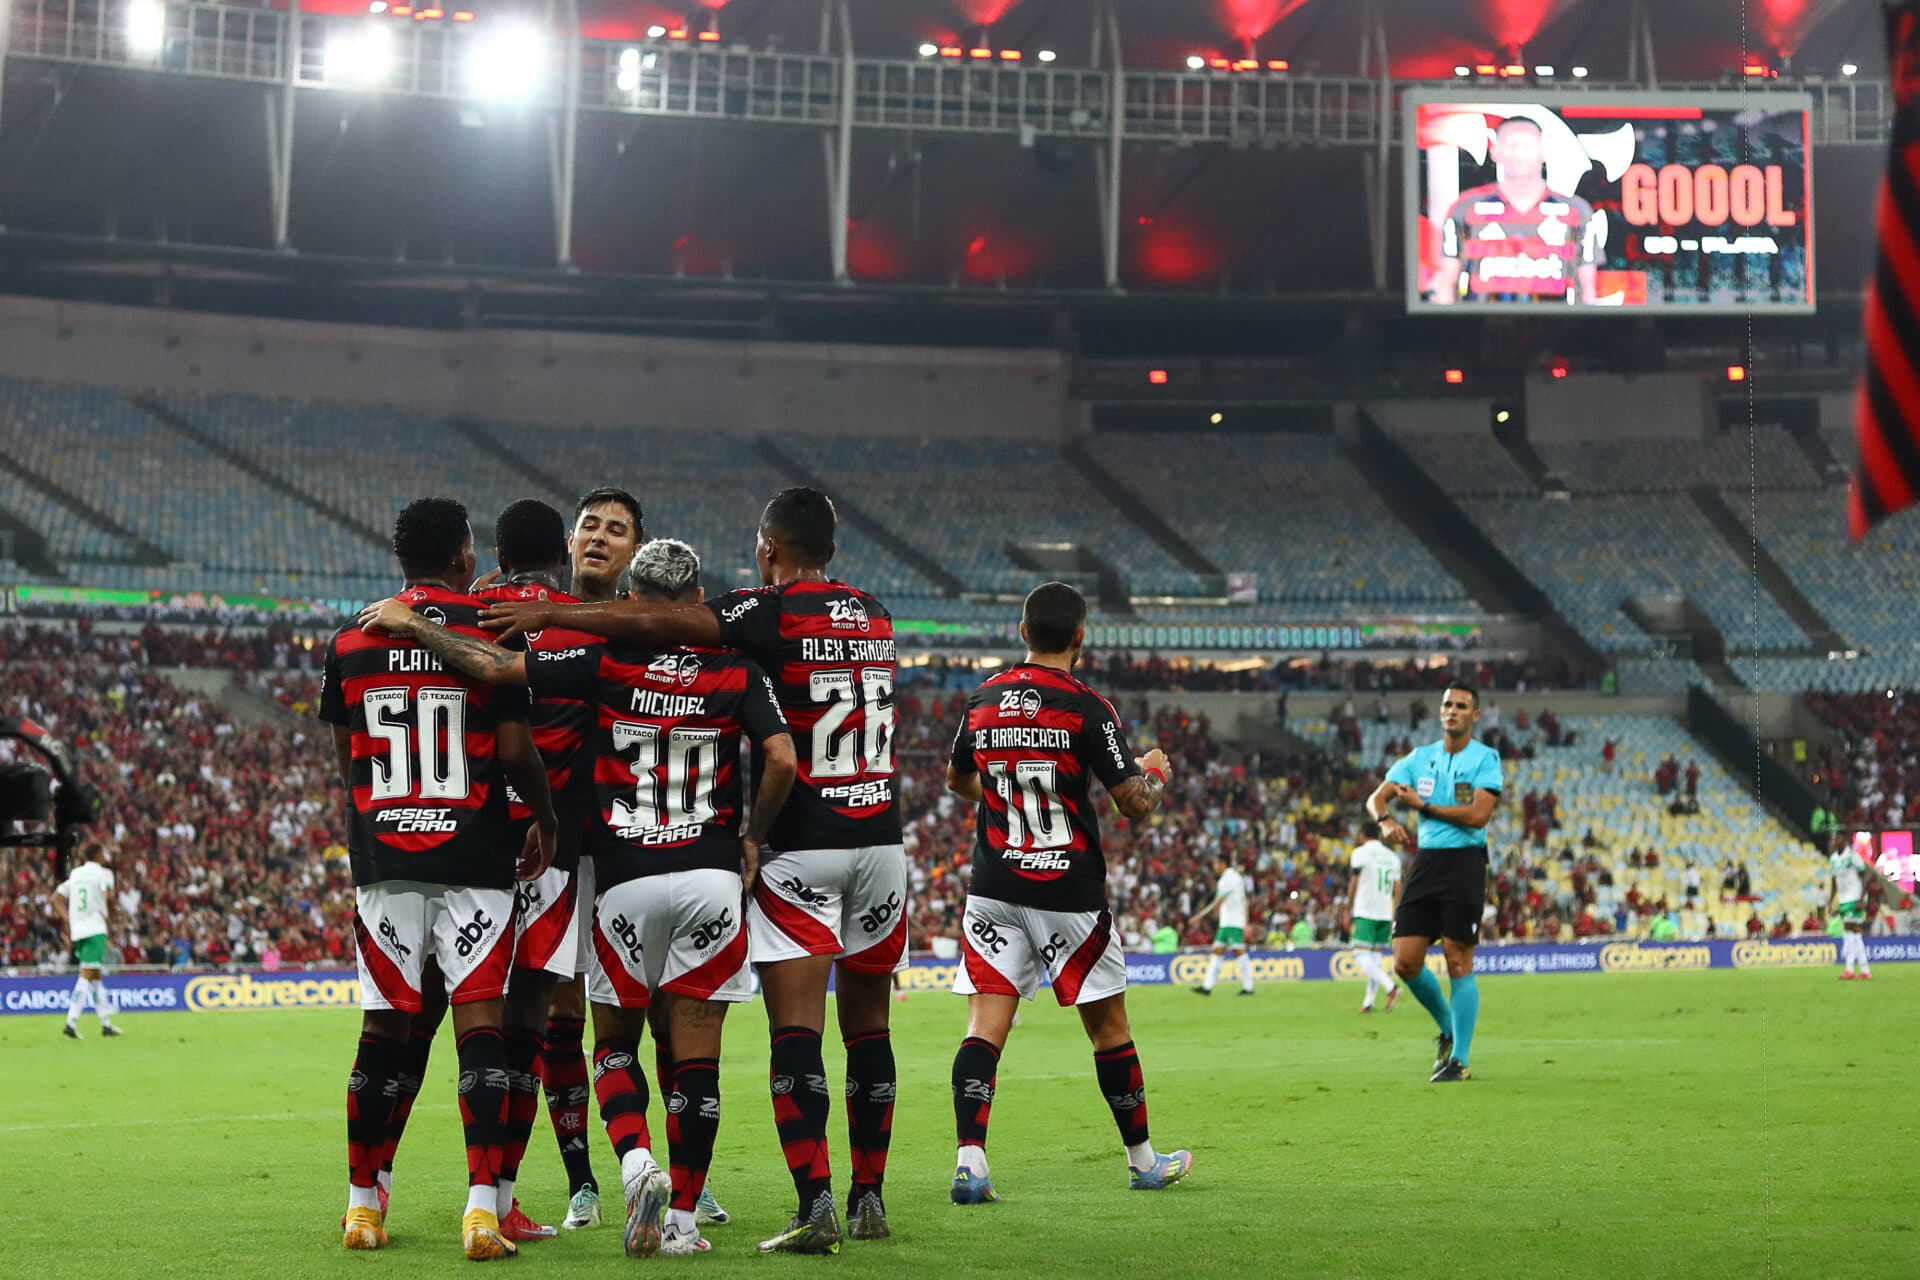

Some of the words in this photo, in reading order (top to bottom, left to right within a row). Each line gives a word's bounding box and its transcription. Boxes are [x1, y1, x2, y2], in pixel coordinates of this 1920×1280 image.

[1622, 164, 1796, 226] GOOOL
[802, 638, 844, 661] ALEX
[848, 639, 895, 661] SANDRO
[644, 671, 676, 684] DELIVERY
[821, 675, 849, 684] TEXACO
[374, 692, 403, 701] TEXACO
[429, 692, 461, 701] TEXACO
[630, 687, 706, 717] MICHAEL
[622, 727, 653, 738] TEXACO
[809, 666, 896, 778] 26
[363, 685, 470, 800] 50
[682, 733, 714, 741] TEXACO
[975, 730, 987, 750] DE
[991, 727, 1070, 750] ARRASCAETA
[1101, 720, 1126, 770] Shopee
[607, 719, 721, 826] 30
[848, 788, 892, 808] CARD
[986, 760, 1073, 849] 10
[375, 807, 452, 821] ASSIST
[397, 819, 458, 832] CARD
[642, 823, 703, 846] CARD
[1020, 859, 1071, 870] CARD
[78, 887, 88, 912] 3
[859, 889, 901, 933] abc
[379, 915, 412, 964] abc
[454, 908, 493, 957] abc
[611, 912, 644, 964] abc
[690, 906, 733, 950] abc
[971, 918, 1009, 955] abc
[6, 989, 72, 1010] CABOS
